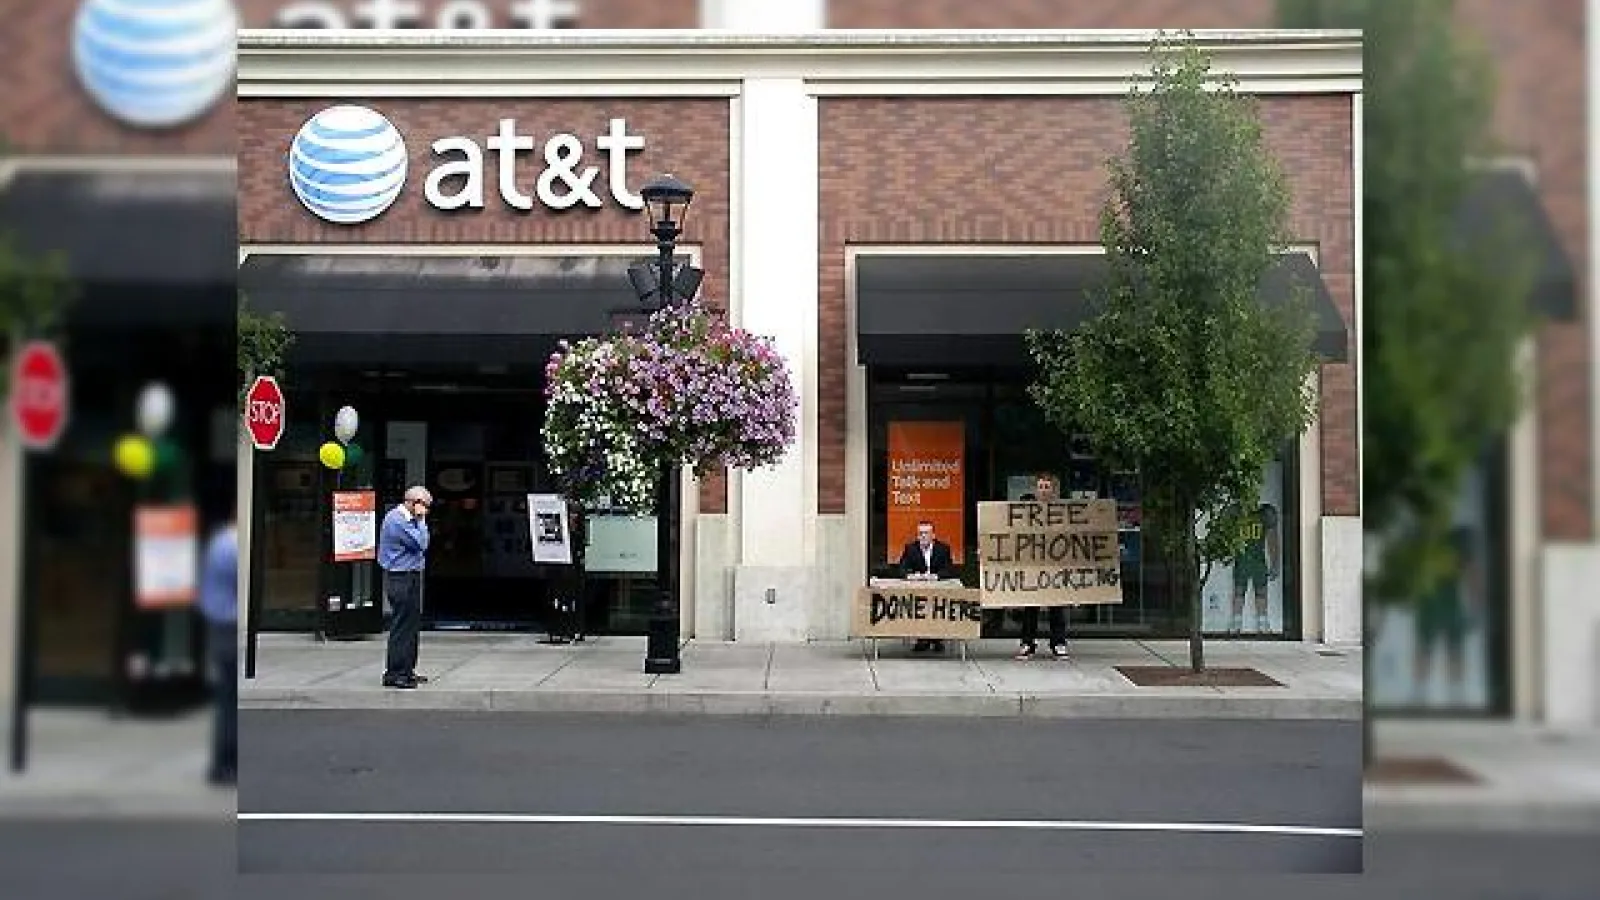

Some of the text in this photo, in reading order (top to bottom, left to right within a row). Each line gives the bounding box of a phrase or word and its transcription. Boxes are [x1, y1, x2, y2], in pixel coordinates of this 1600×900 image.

[424, 118, 646, 210] at&t
[250, 401, 281, 424] STOP
[892, 458, 960, 475] Unlimited
[892, 475, 951, 490] Talk and
[892, 490, 921, 505] Text
[1007, 503, 1089, 527] FREE
[983, 568, 1119, 592] UNLOCKING
[869, 593, 981, 626] DONE HERE
